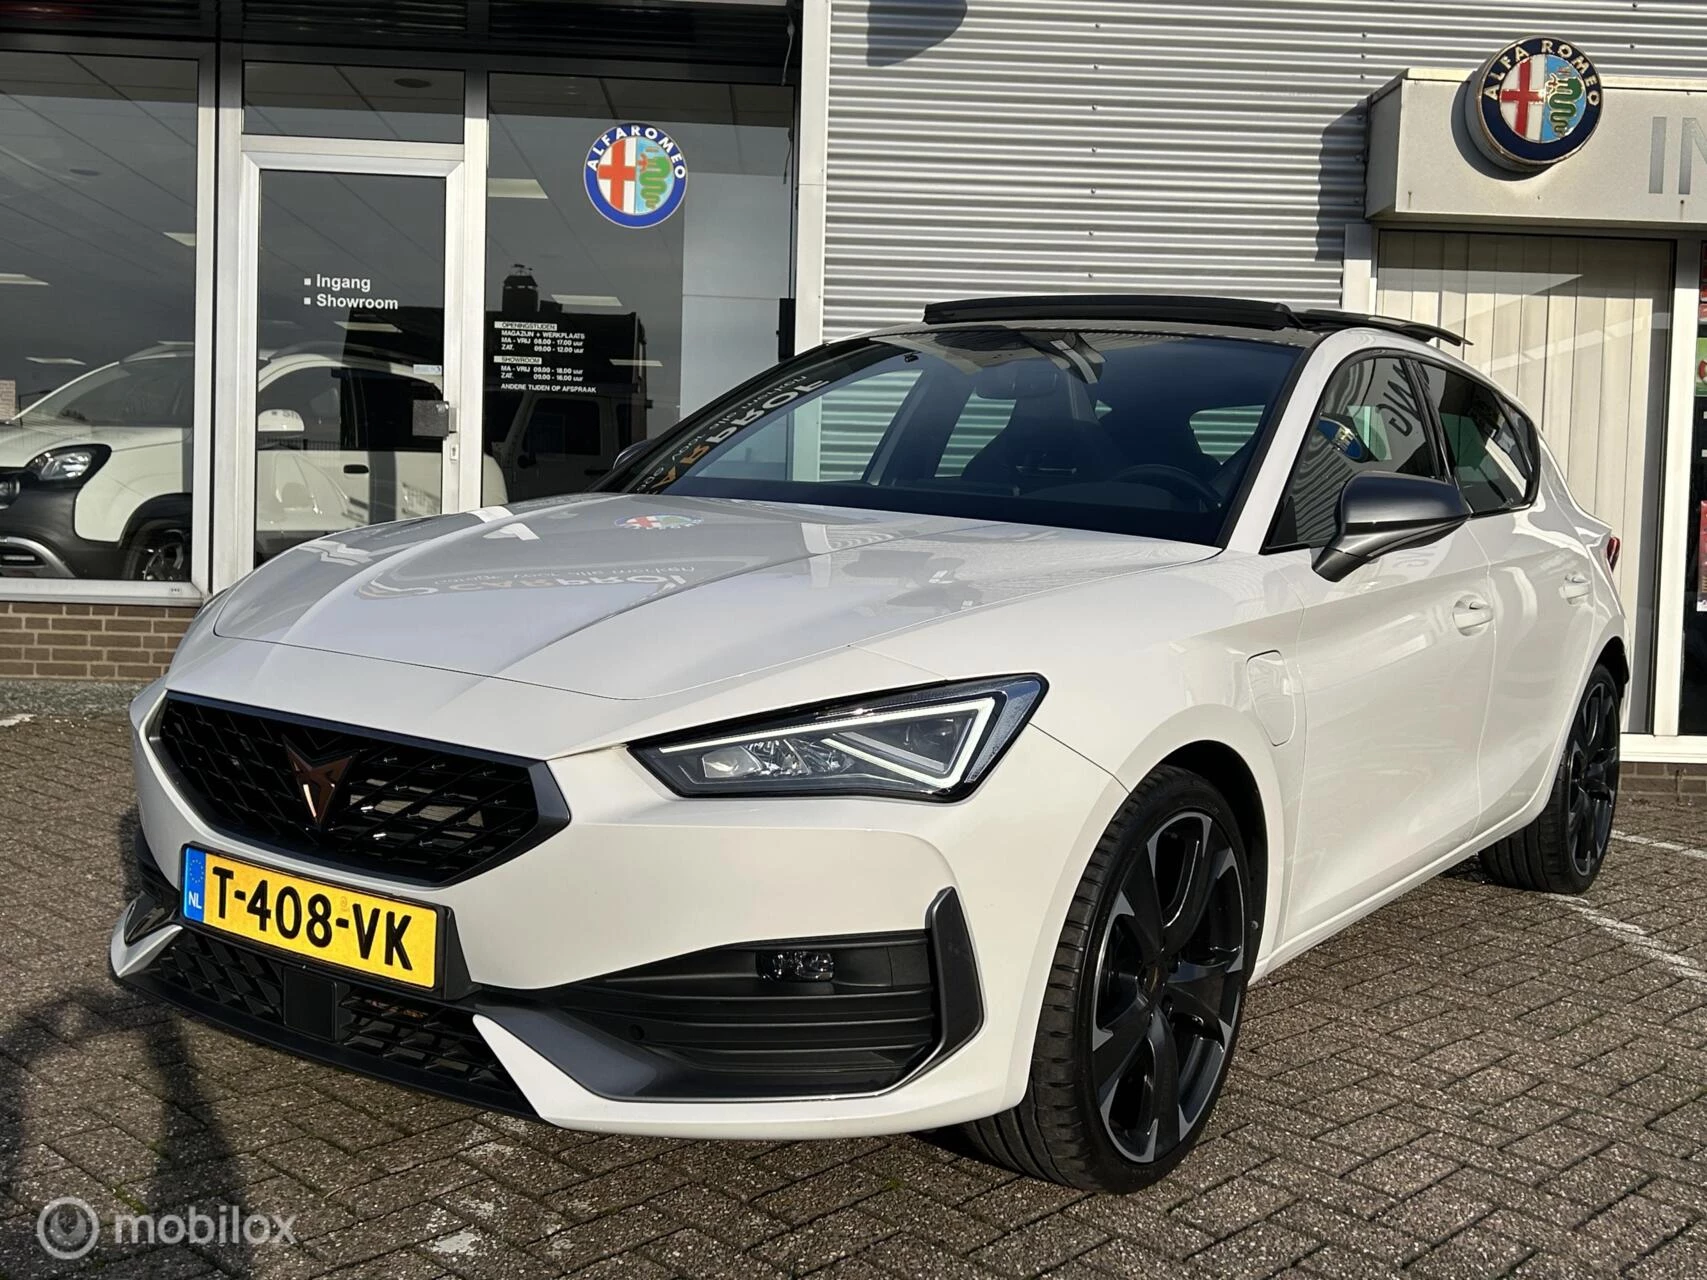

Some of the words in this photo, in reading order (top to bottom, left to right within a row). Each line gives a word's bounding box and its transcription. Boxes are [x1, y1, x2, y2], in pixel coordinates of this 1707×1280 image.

[1483, 45, 1530, 101] ALFA
[1541, 40, 1600, 106] ROMEO
[316, 273, 371, 293] Ingang
[316, 293, 399, 310] Showroom
[542, 331, 585, 339] WERKPLAATS
[188, 891, 203, 910] NL
[212, 866, 413, 971] T-408-VK
